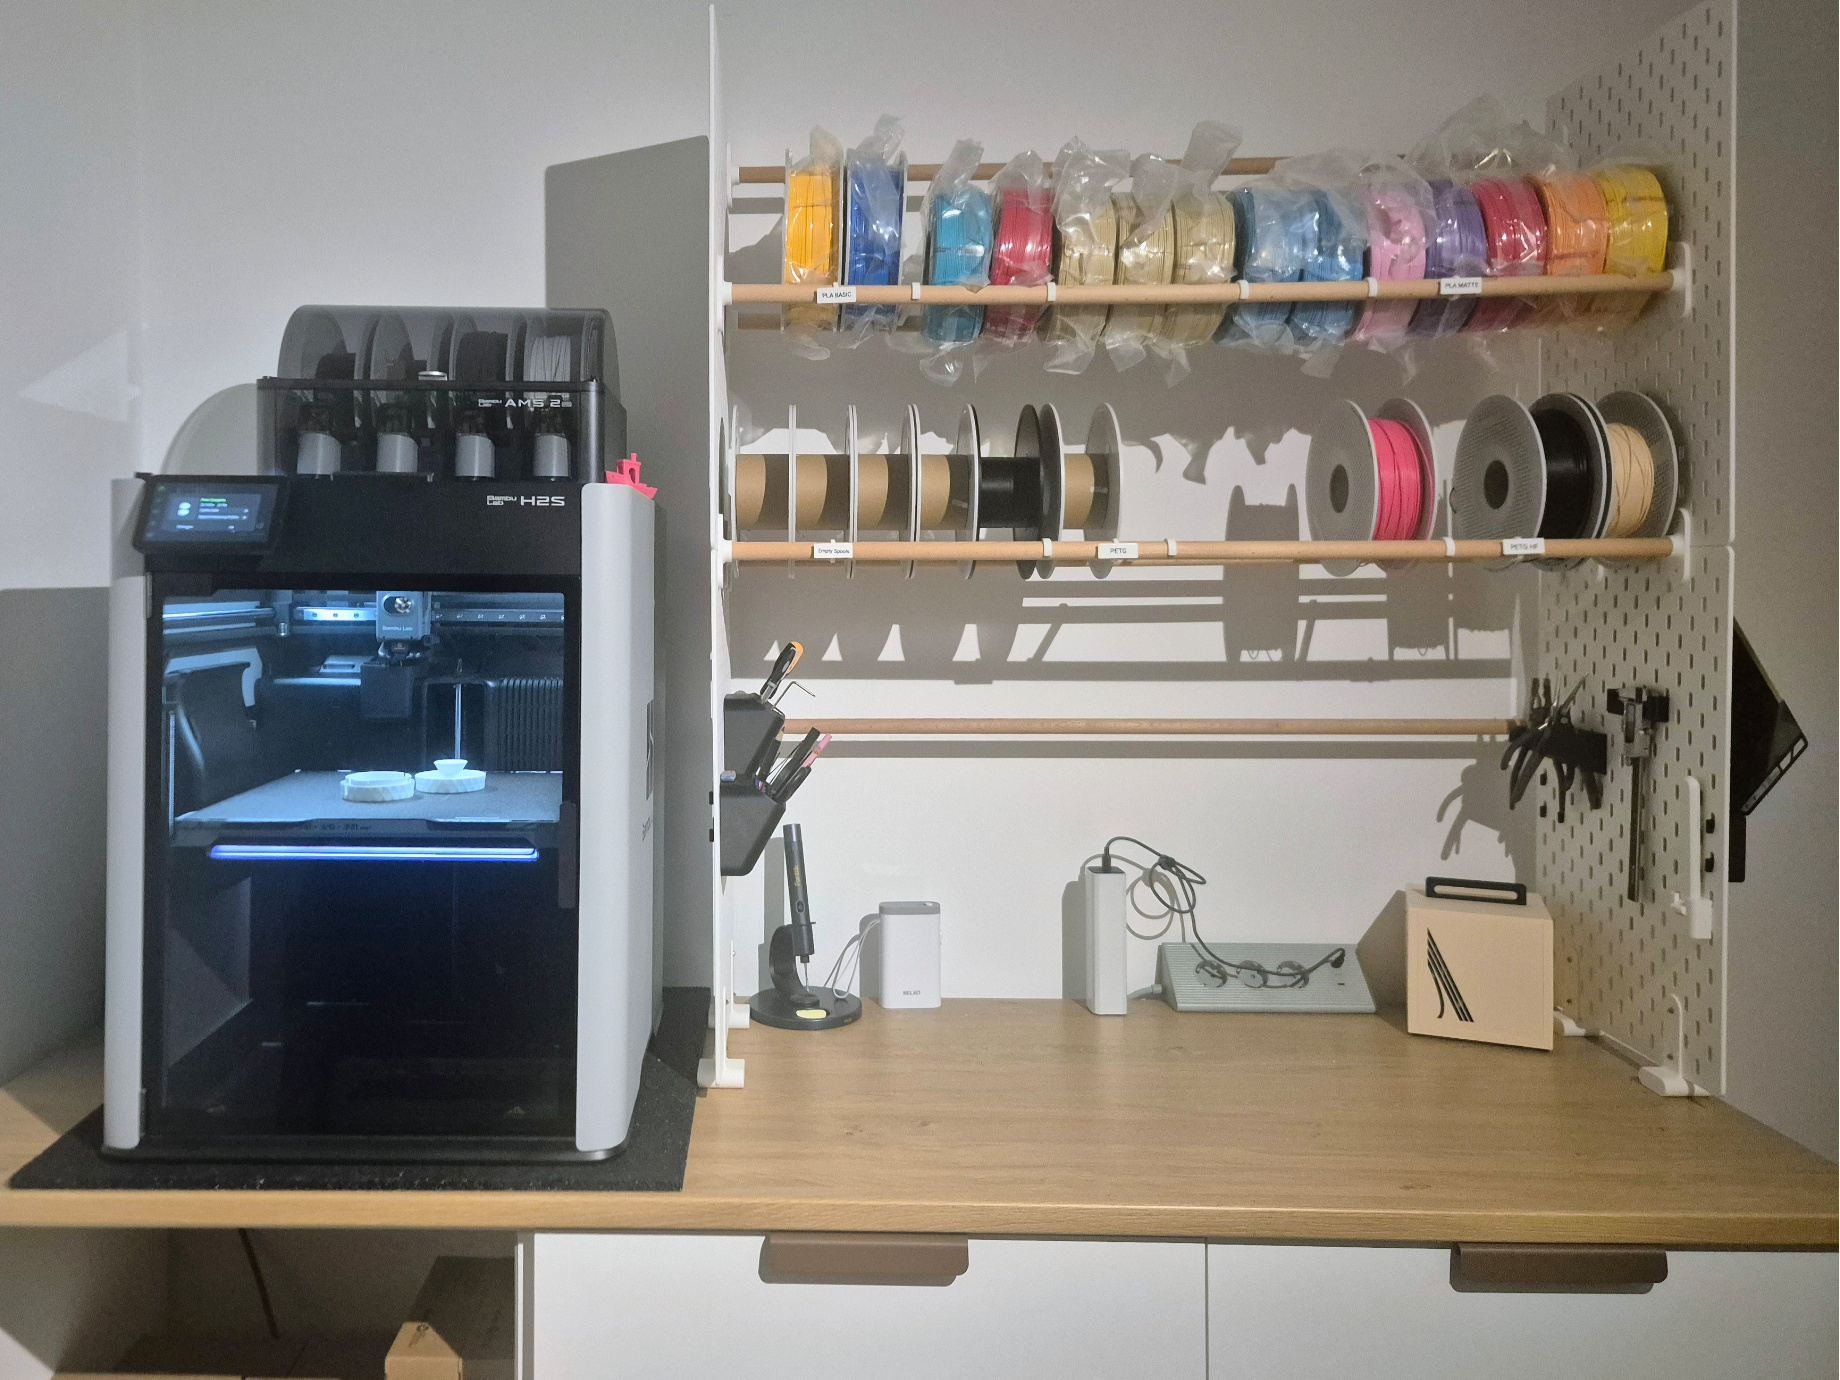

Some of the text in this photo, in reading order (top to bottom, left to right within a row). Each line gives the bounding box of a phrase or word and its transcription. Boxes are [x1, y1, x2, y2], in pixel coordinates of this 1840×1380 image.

[505, 399, 544, 407] AMS
[550, 399, 561, 407] 2
[520, 495, 565, 506] H2S
